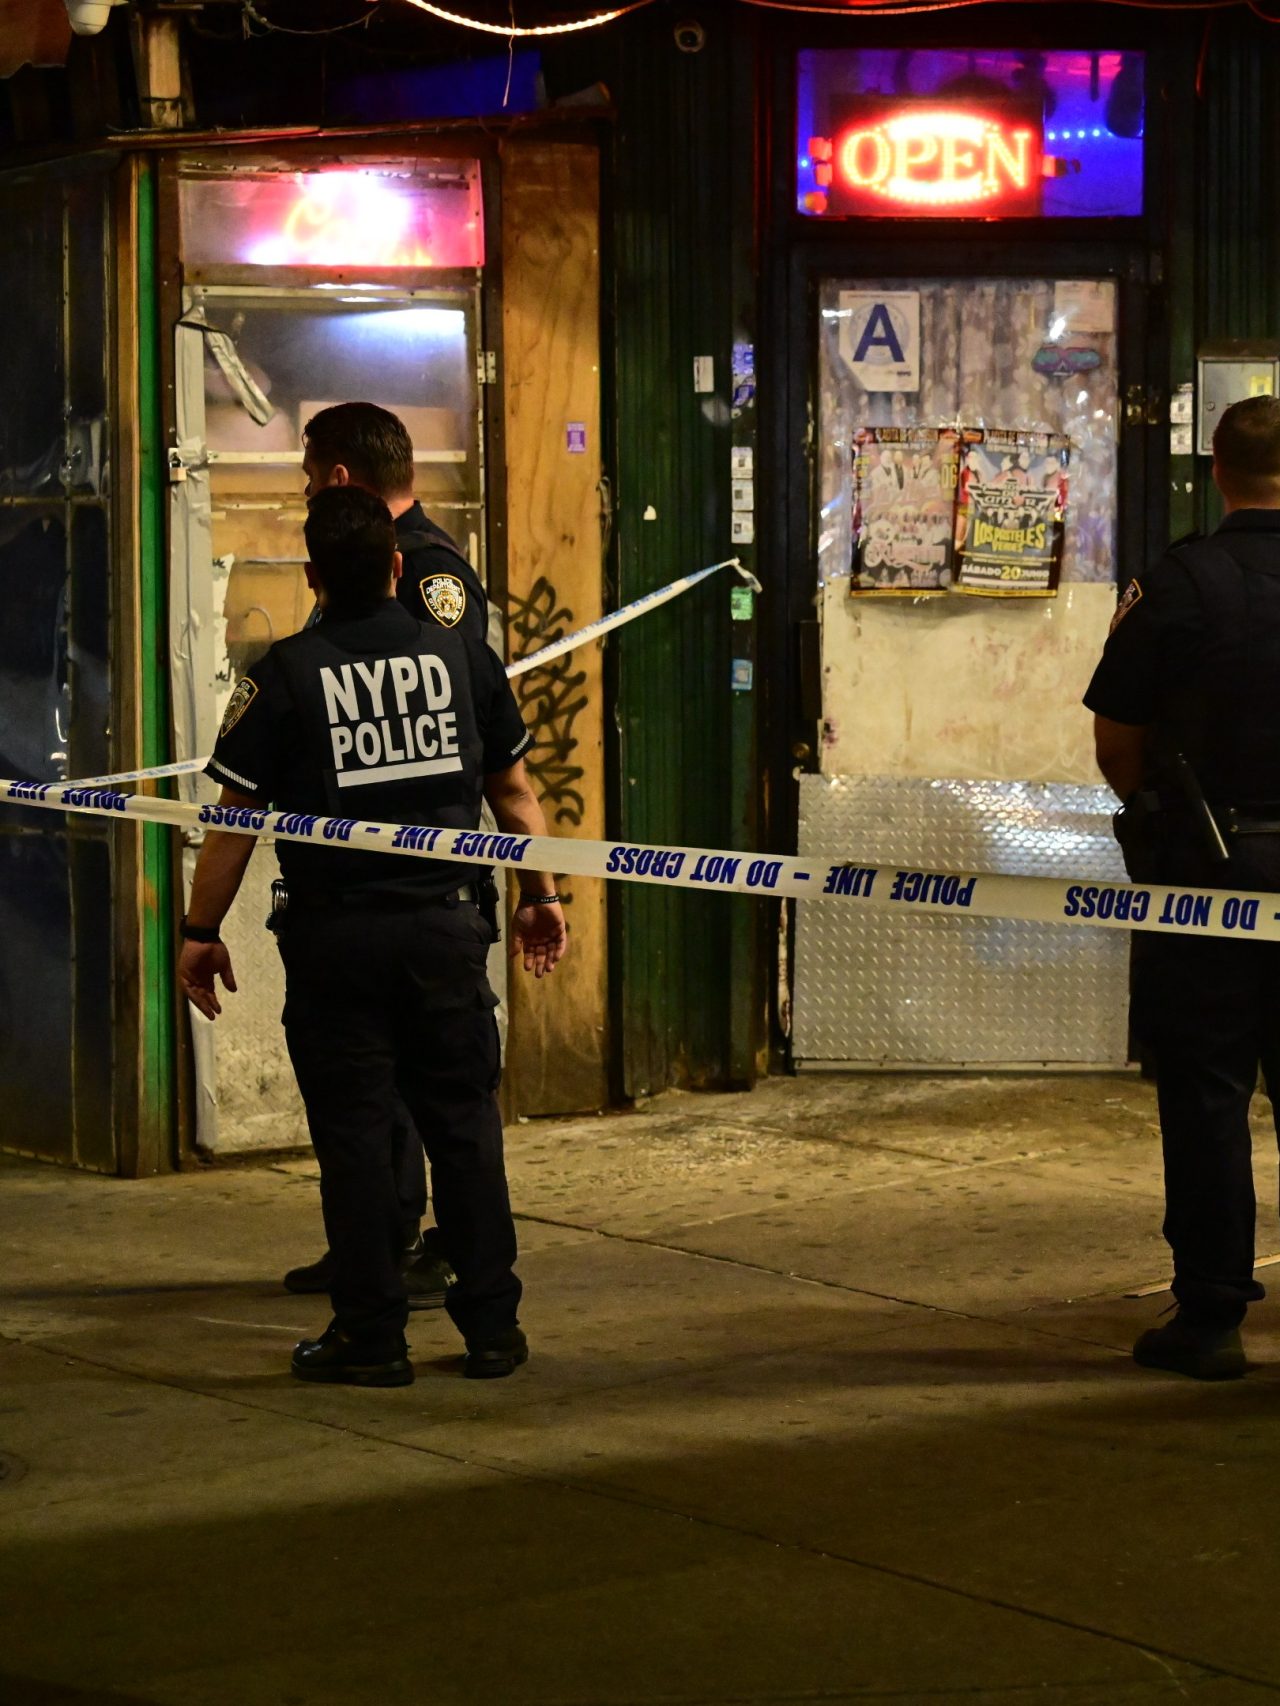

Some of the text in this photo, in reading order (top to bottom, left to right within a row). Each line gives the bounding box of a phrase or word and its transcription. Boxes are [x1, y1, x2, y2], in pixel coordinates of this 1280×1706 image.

[842, 131, 1032, 188] OPEN
[852, 303, 906, 362] A
[1000, 565, 1021, 580] 20
[320, 654, 453, 724] NYPD
[331, 712, 460, 770] POLICE
[199, 805, 532, 861] POLICE LINE DO NOT CROSS
[606, 846, 977, 907] POLICE LINE DO NOT CROSS
[1064, 886, 1151, 922] CROSS
[1159, 893, 1212, 927] NOT
[1221, 898, 1260, 930] DO
